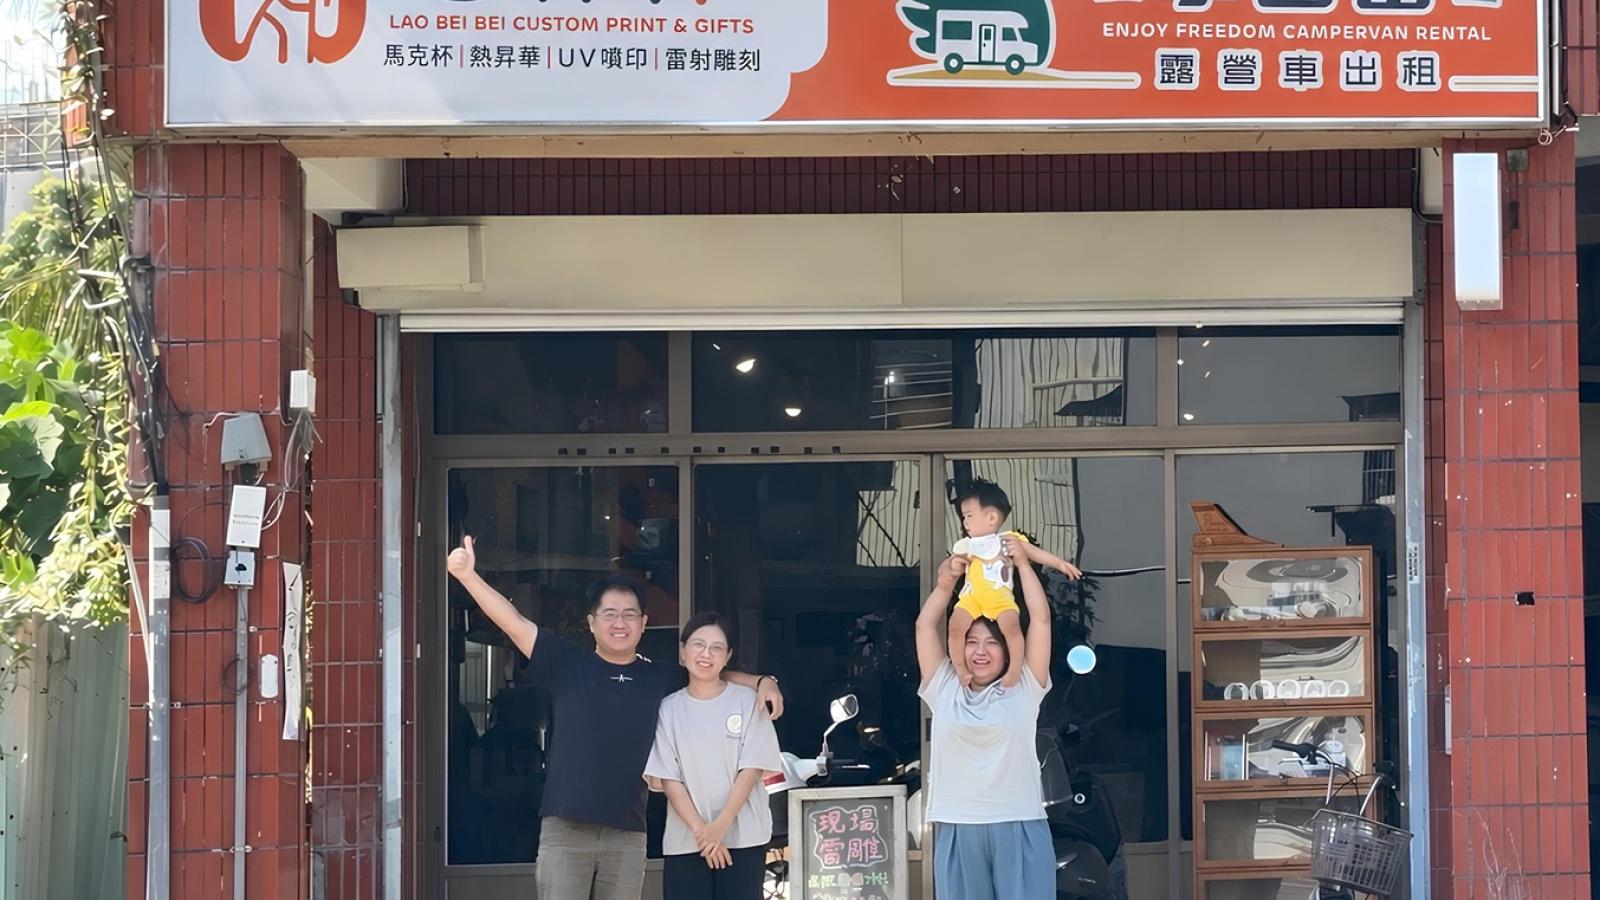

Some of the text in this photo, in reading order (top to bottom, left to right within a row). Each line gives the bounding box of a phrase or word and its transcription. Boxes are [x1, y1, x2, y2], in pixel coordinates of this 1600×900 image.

[390, 15, 754, 33] LAO BEI BEI CUSTOM PRINT & GIFTS
[1103, 22, 1491, 40] ENJOY FREEDOM CAMPERVAN RENTAL
[384, 44, 453, 68] 馬克杯
[470, 45, 541, 69] 熱昇華
[666, 48, 760, 71] 雷射雕刻
[1158, 53, 1437, 87] 露營車出租
[818, 808, 880, 834] 現場
[819, 837, 883, 866] 雷雕
